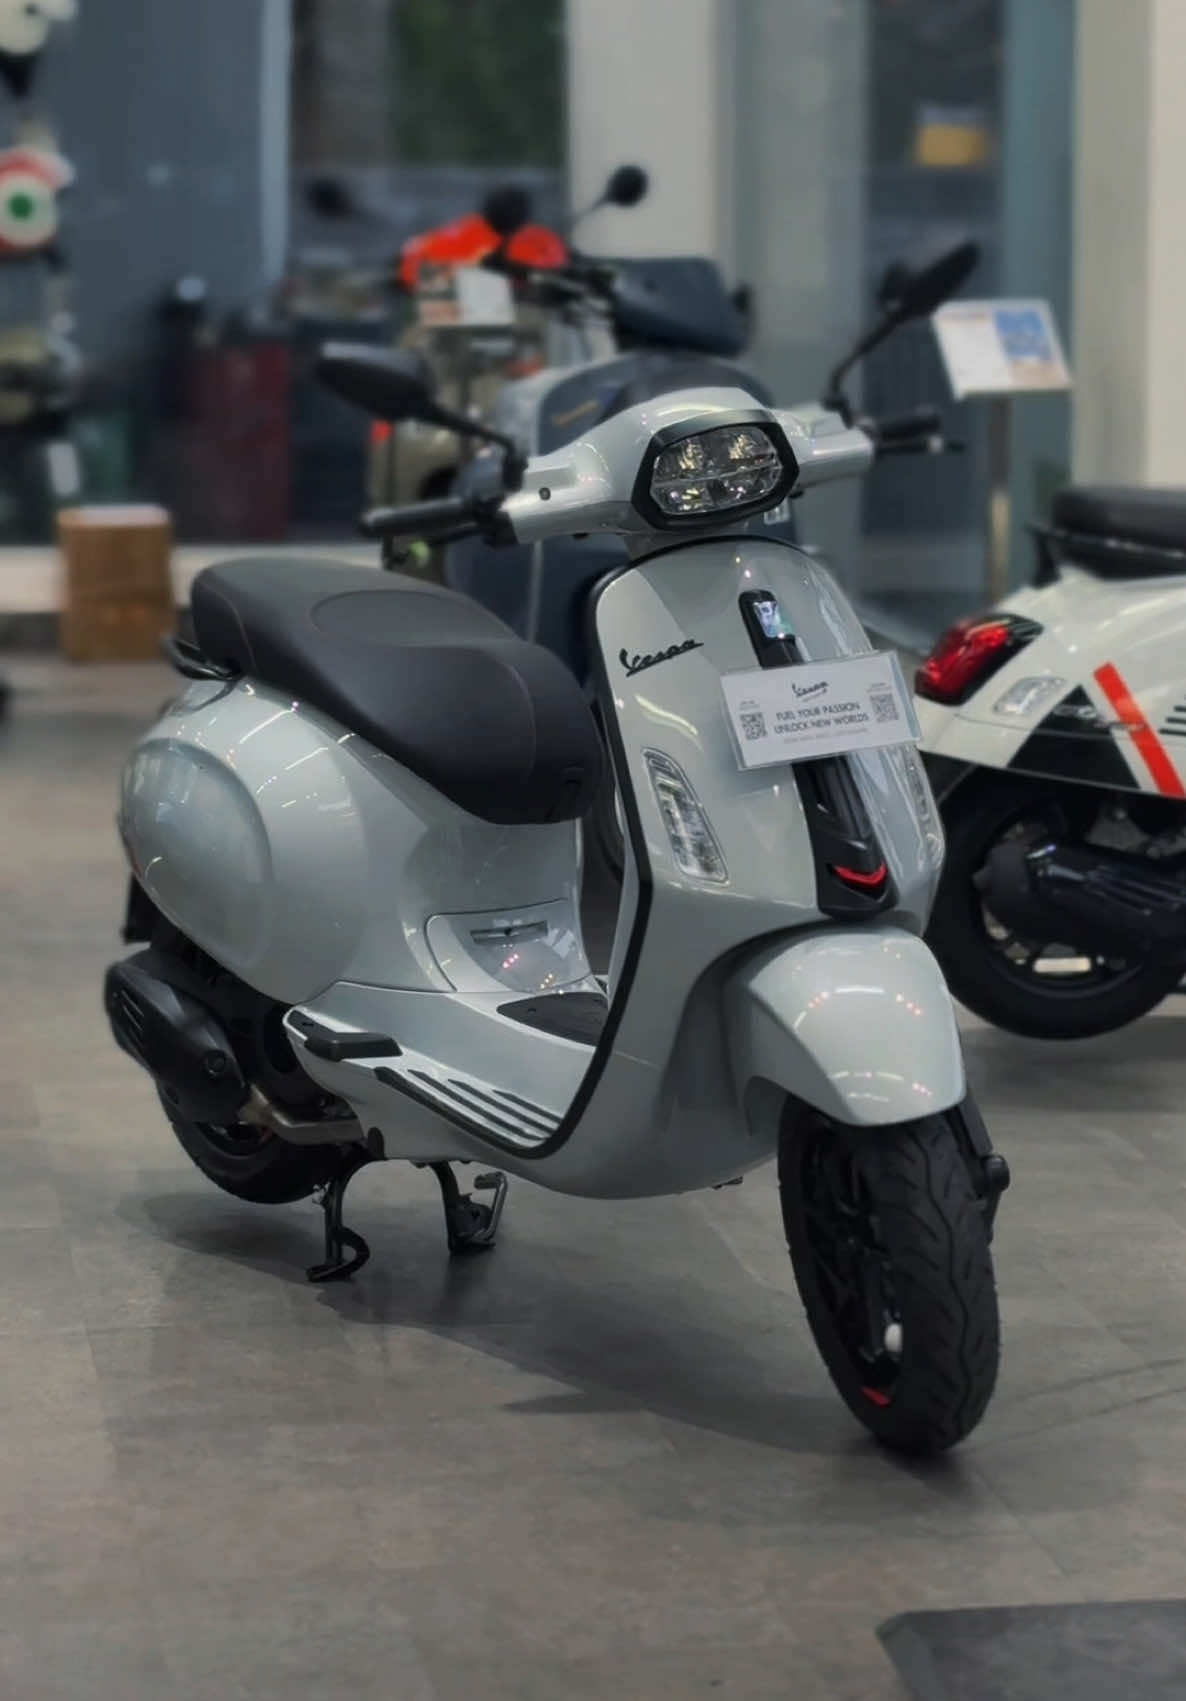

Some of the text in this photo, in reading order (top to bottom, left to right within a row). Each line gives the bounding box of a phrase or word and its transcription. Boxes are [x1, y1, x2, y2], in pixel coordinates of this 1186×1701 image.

[619, 639, 704, 677] Vespa
[776, 702, 860, 721] FUEL YOUR PASSION
[774, 713, 869, 734] UNLOCK NEW WORLDS
